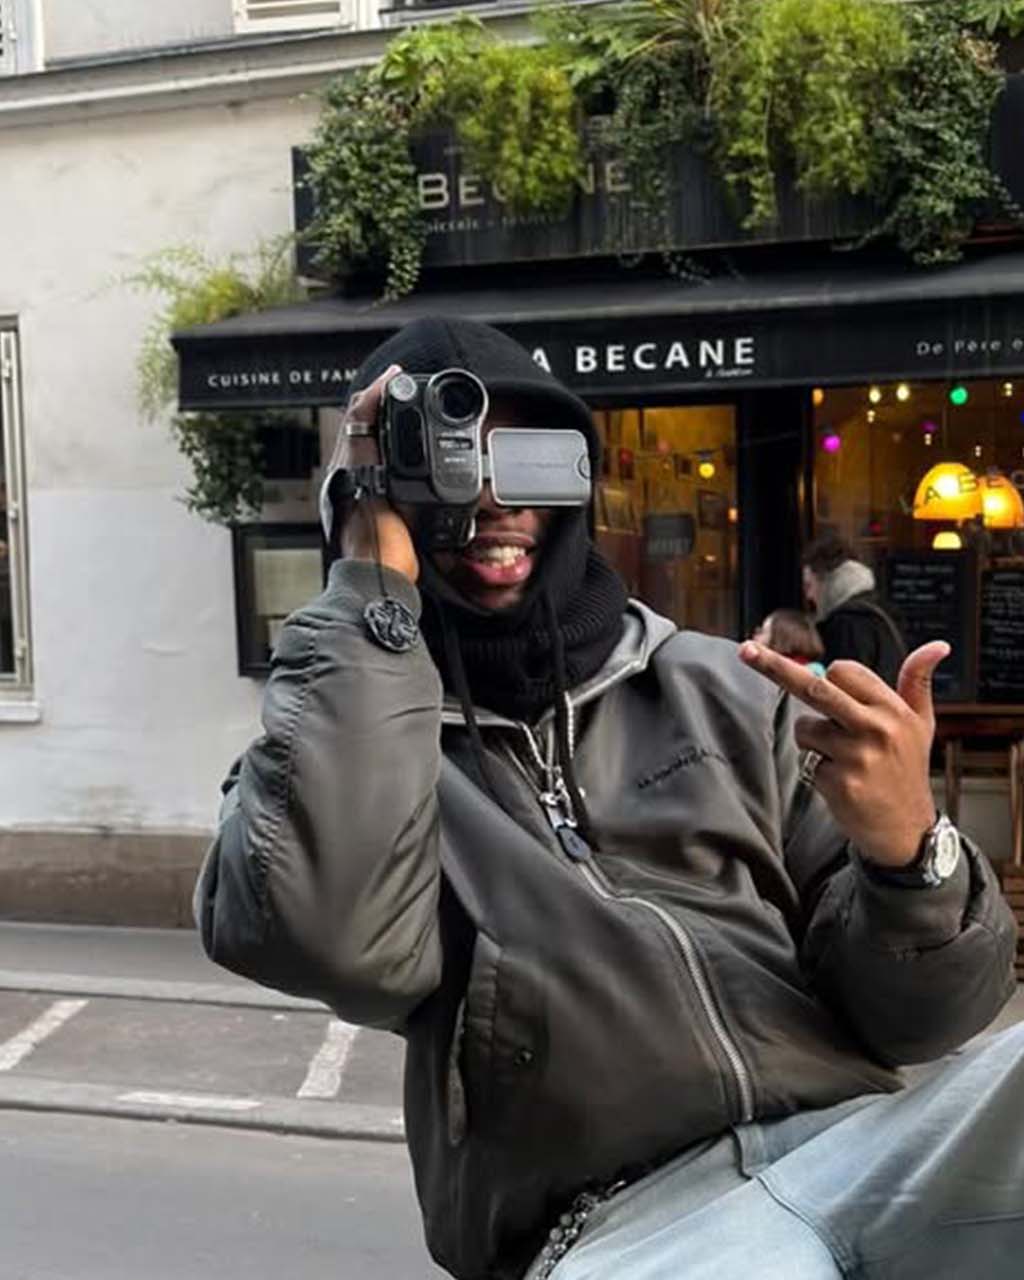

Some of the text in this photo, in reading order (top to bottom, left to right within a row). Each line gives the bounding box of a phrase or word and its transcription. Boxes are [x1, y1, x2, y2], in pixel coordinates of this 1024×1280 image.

[532, 337, 755, 374] A BECANE
[916, 341, 944, 356] De
[207, 368, 358, 388] CUISINE DE FAM
